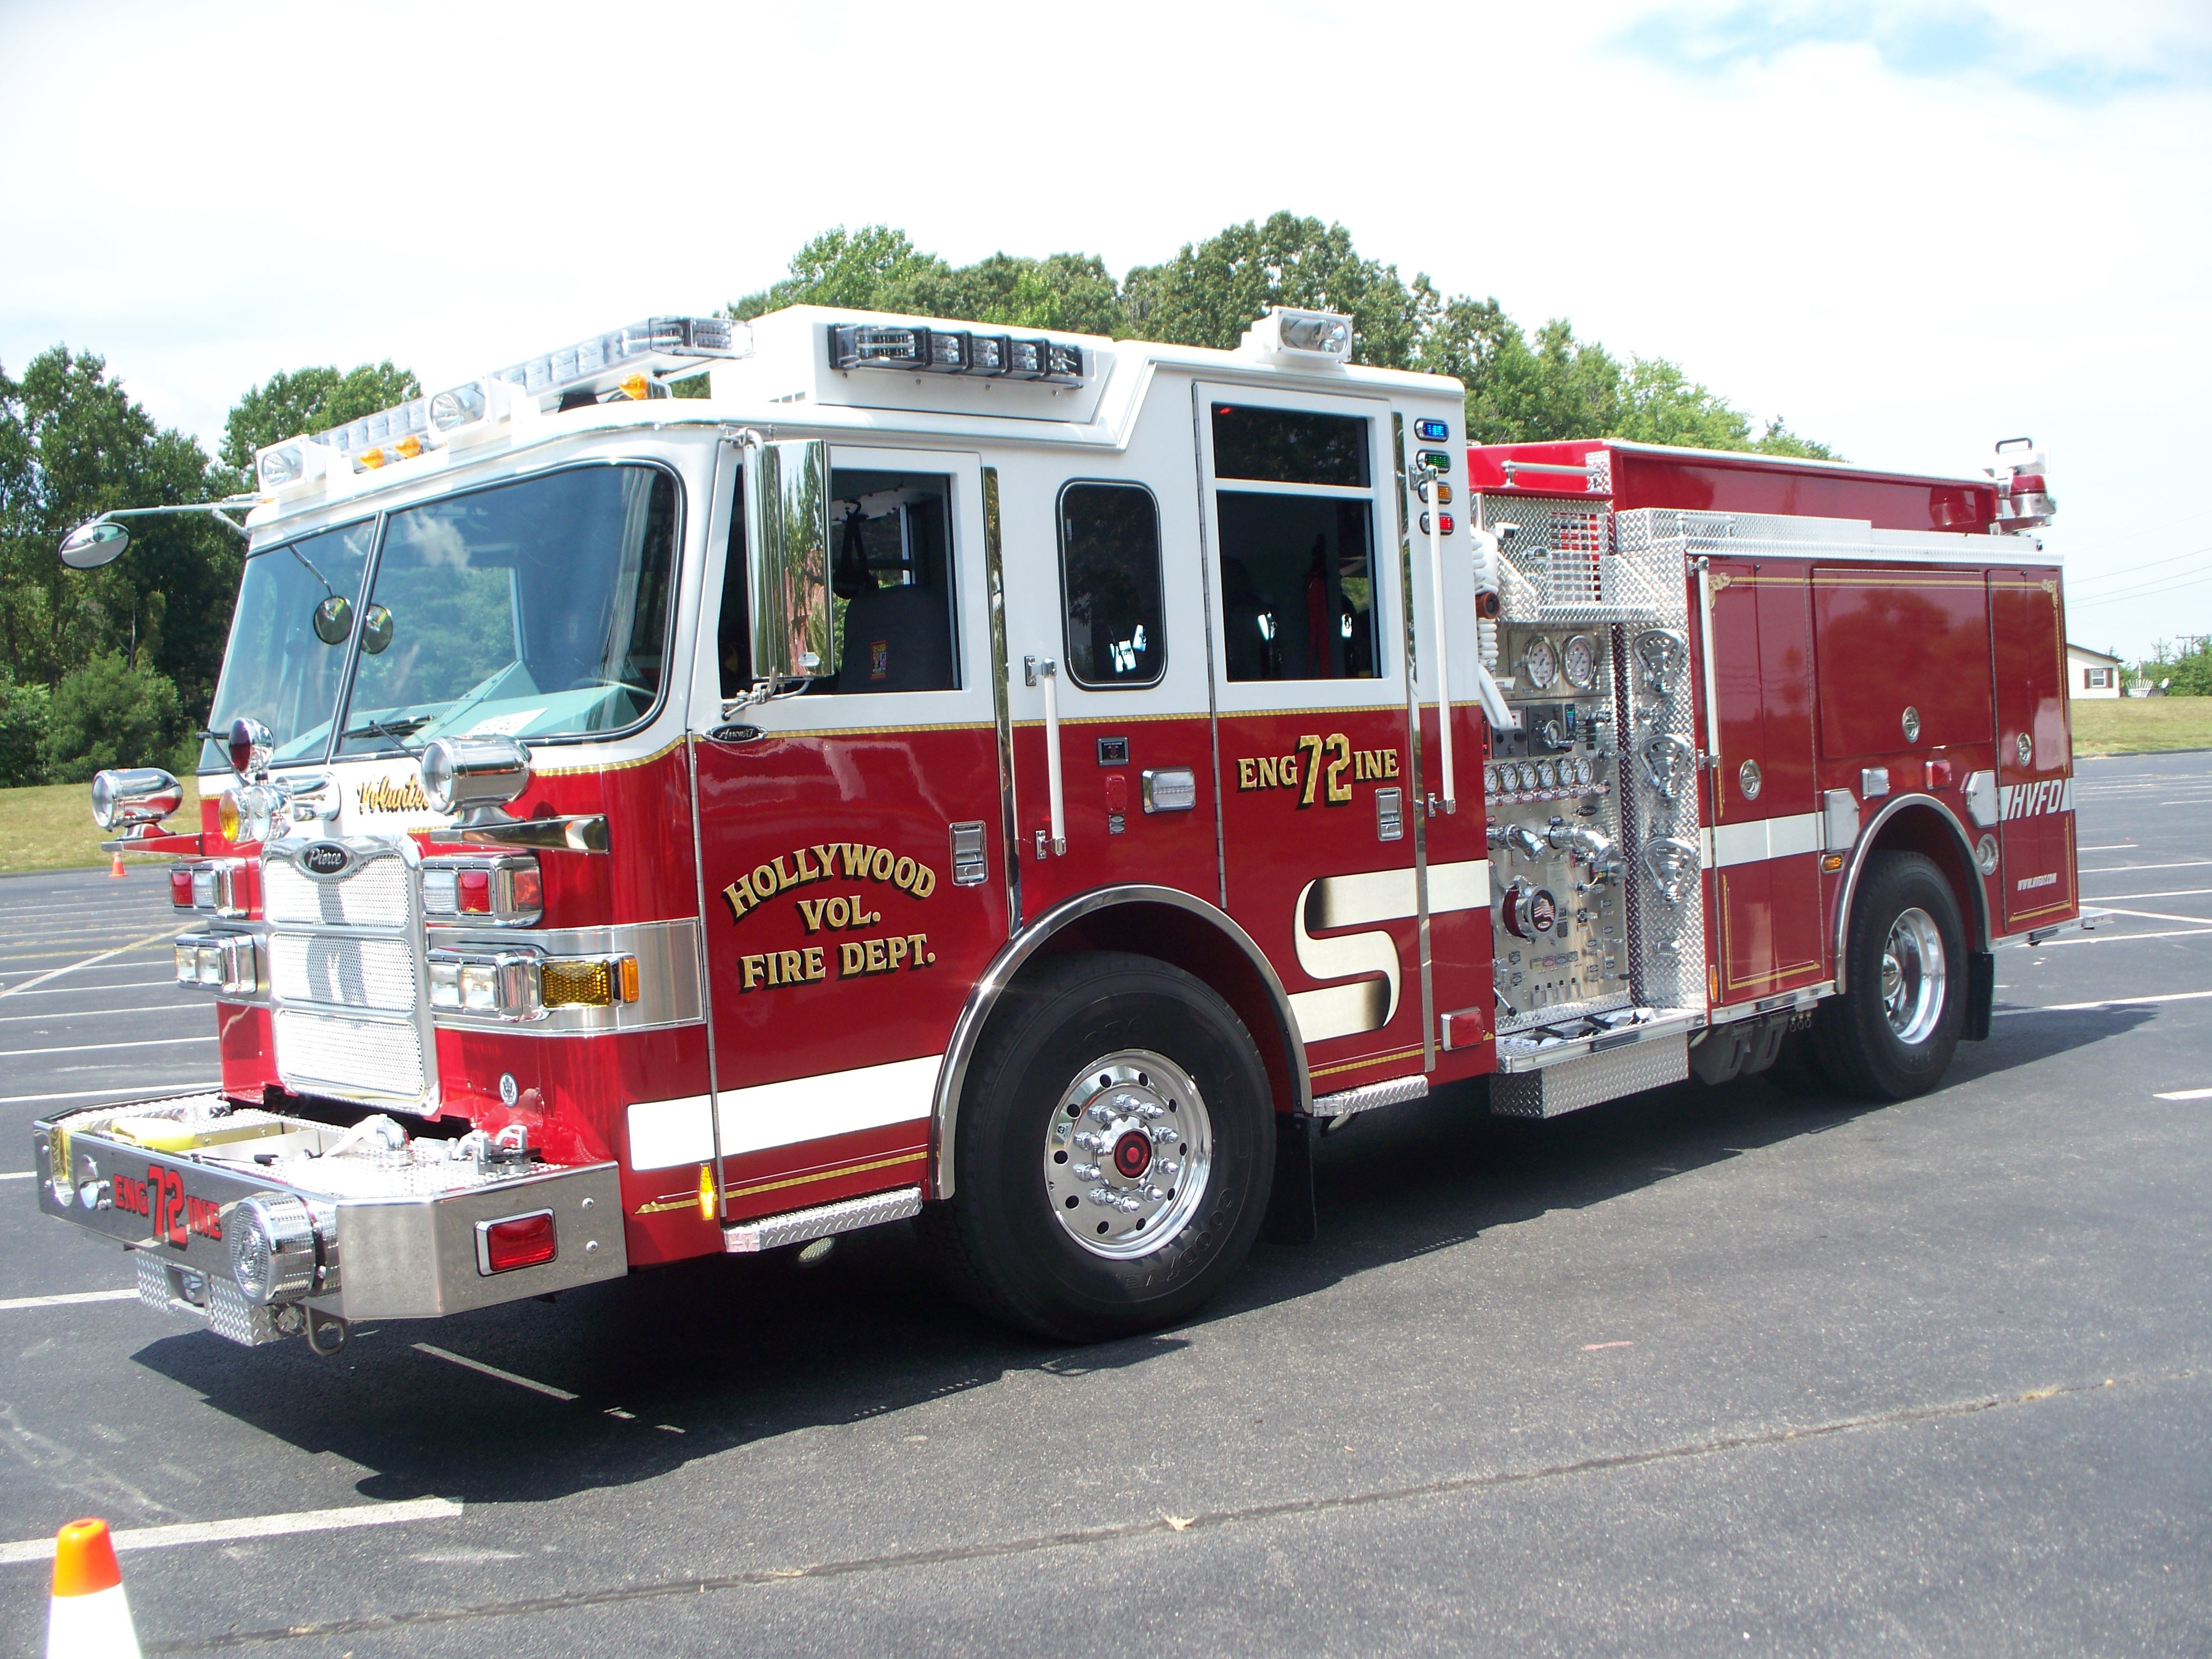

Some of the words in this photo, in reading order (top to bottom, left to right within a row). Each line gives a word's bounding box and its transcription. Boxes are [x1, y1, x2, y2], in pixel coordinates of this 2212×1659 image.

[2009, 779, 2062, 820] HVFD
[308, 847, 342, 869] Pierce
[722, 843, 936, 925] HOLLYWOOD
[795, 895, 881, 935] VOL.
[738, 947, 826, 993] FIRE
[837, 933, 936, 980] DEPT.
